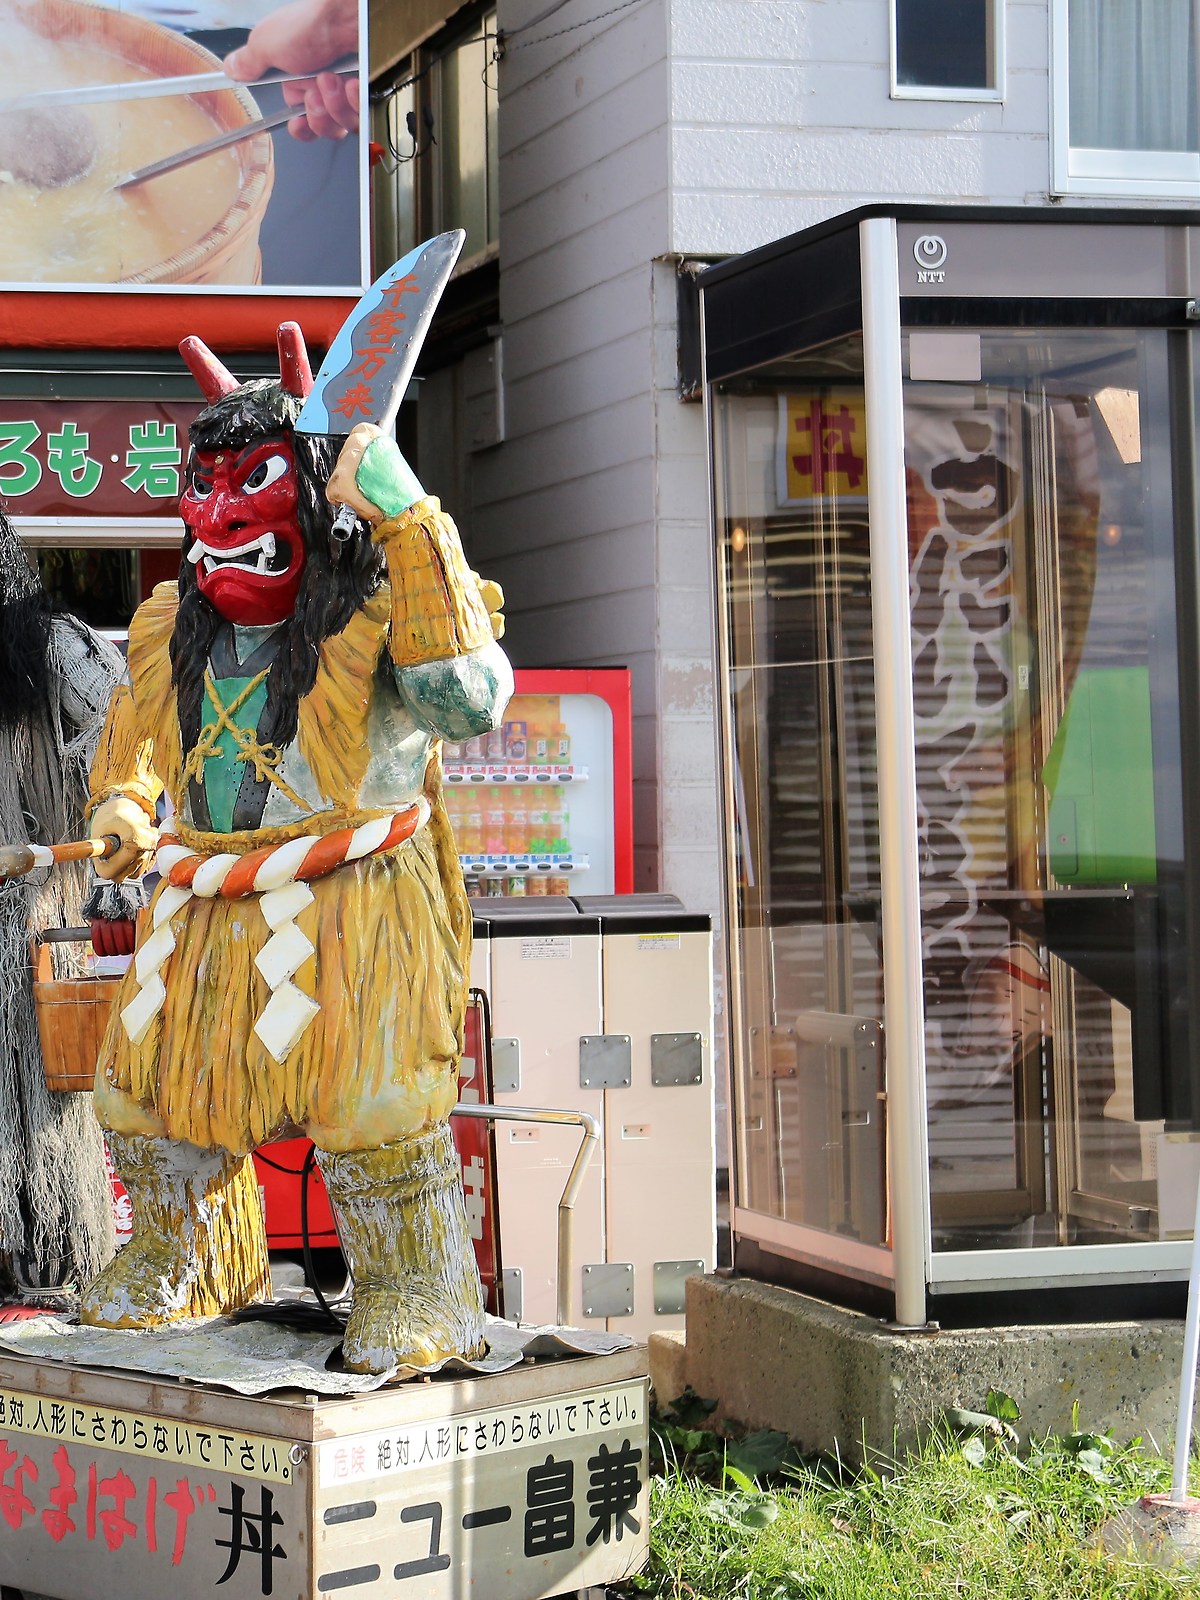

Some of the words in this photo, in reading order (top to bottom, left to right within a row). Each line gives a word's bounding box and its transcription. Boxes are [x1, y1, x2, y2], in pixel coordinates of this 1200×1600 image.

[917, 271, 946, 284] NTT
[331, 274, 421, 418] 千客万来
[333, 1446, 366, 1479] 危険
[215, 1481, 288, 1596] 丼
